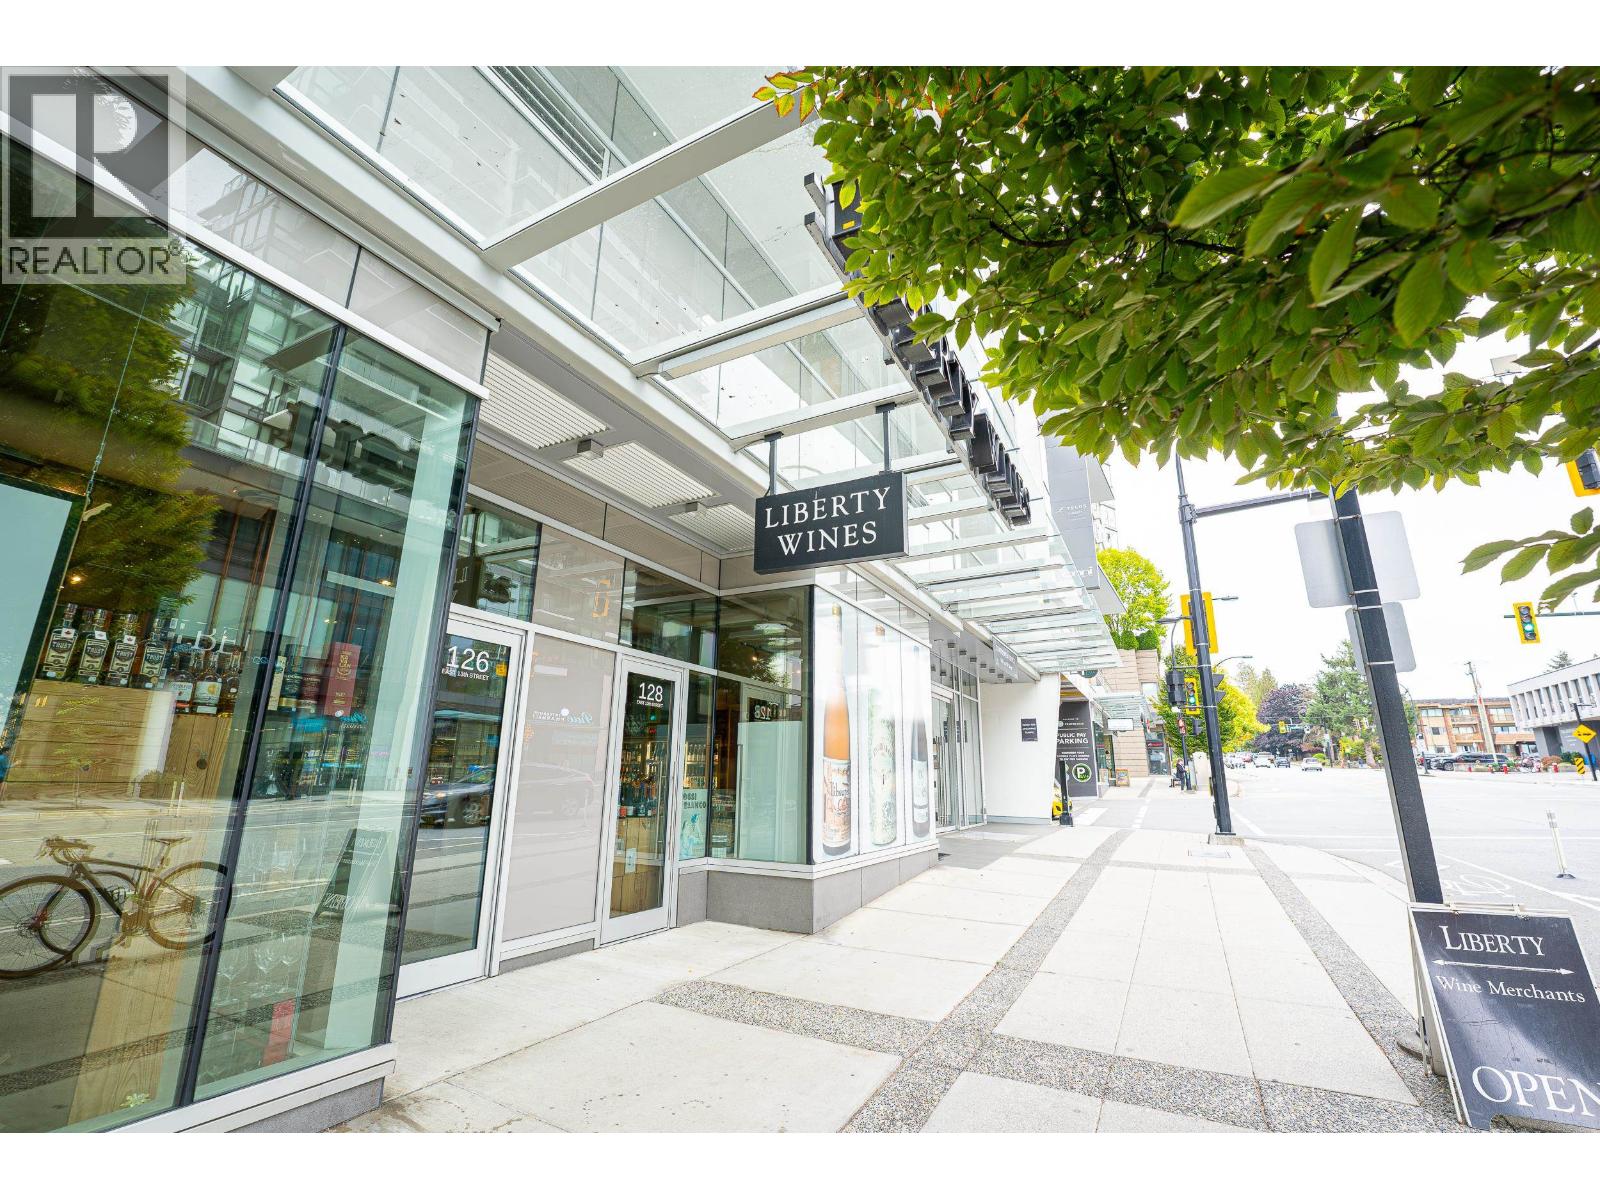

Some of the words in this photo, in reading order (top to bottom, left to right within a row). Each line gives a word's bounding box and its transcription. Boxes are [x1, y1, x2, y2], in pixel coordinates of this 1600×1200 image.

[764, 486, 891, 529] LIBERTY
[777, 520, 878, 556] WINES
[52, 641, 72, 650] TRUST
[86, 646, 105, 655] TRUST
[116, 650, 133, 658] TRUST
[146, 653, 163, 662] TRUST
[446, 645, 490, 673] 126
[638, 682, 664, 703] 128
[1076, 767, 1086, 779] P
[1439, 925, 1546, 956] LIBERTY
[1435, 975, 1483, 994] Wine
[1487, 980, 1586, 1003] Merchants
[1471, 1065, 1600, 1117] OPEN
